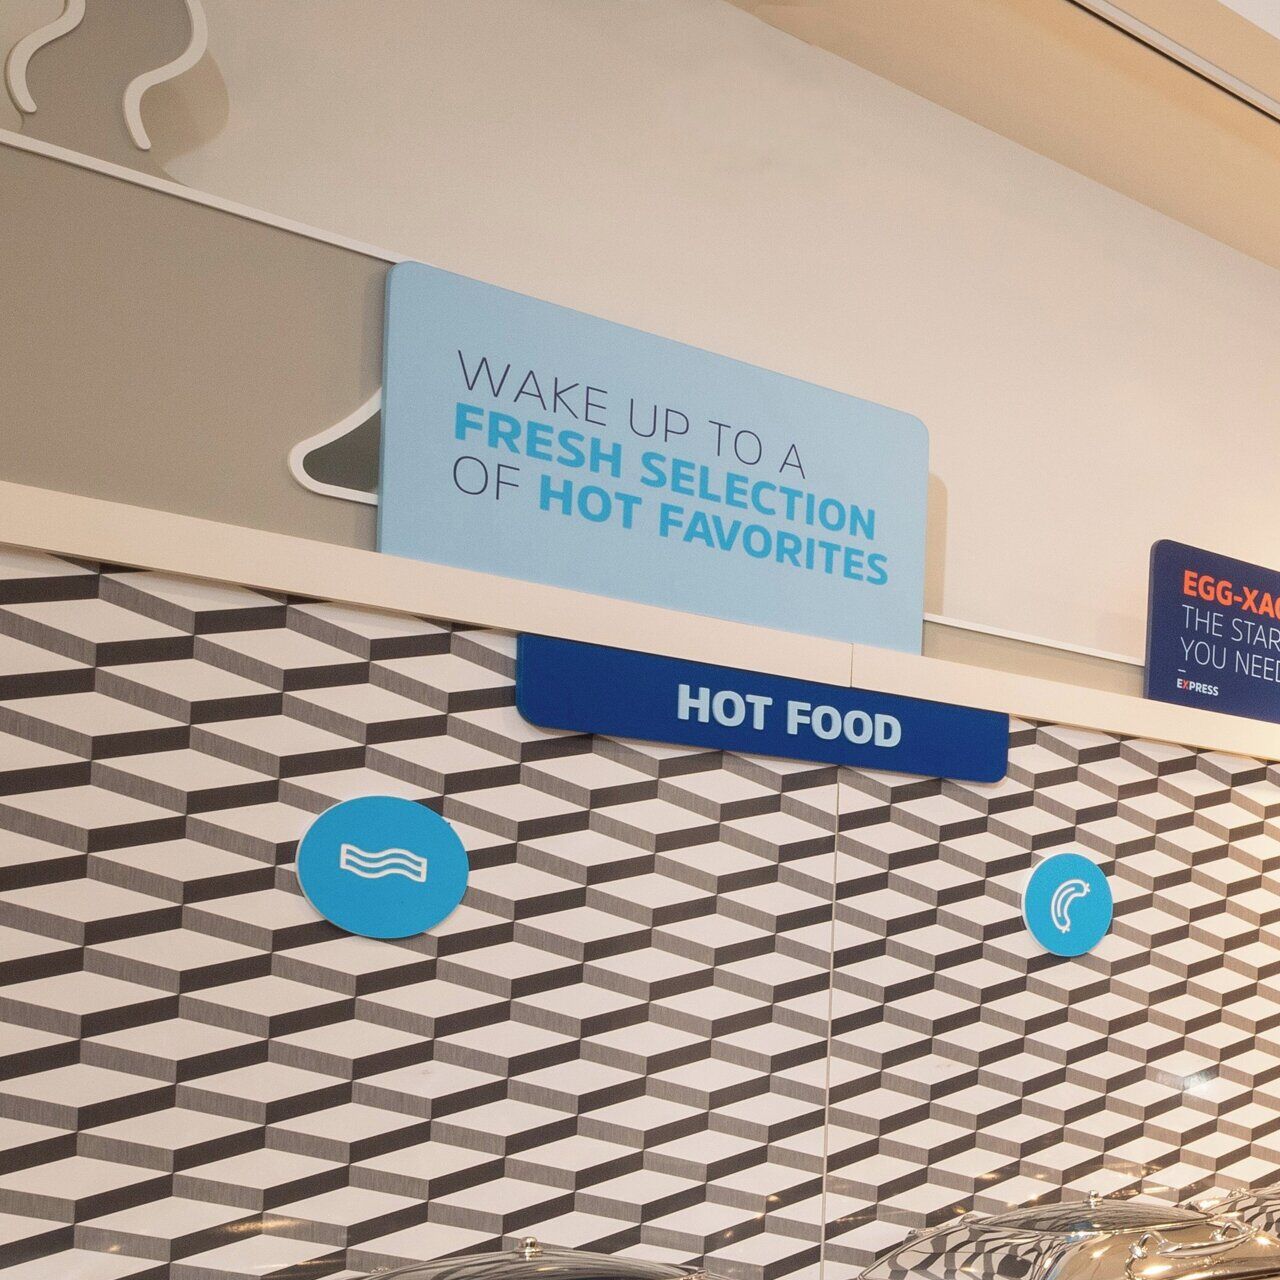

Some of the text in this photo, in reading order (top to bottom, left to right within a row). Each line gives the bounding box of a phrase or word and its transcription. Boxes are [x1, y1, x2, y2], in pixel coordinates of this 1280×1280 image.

[457, 350, 806, 480] WAKE UP TO A
[454, 401, 876, 541] FRESH SELECTION
[452, 456, 889, 586] OF HOT FAVORITES
[1180, 635, 1227, 669] YOU
[1182, 604, 1223, 638] THE
[677, 683, 902, 748] HOT FOOD
[1176, 677, 1219, 698] EXPRESS
